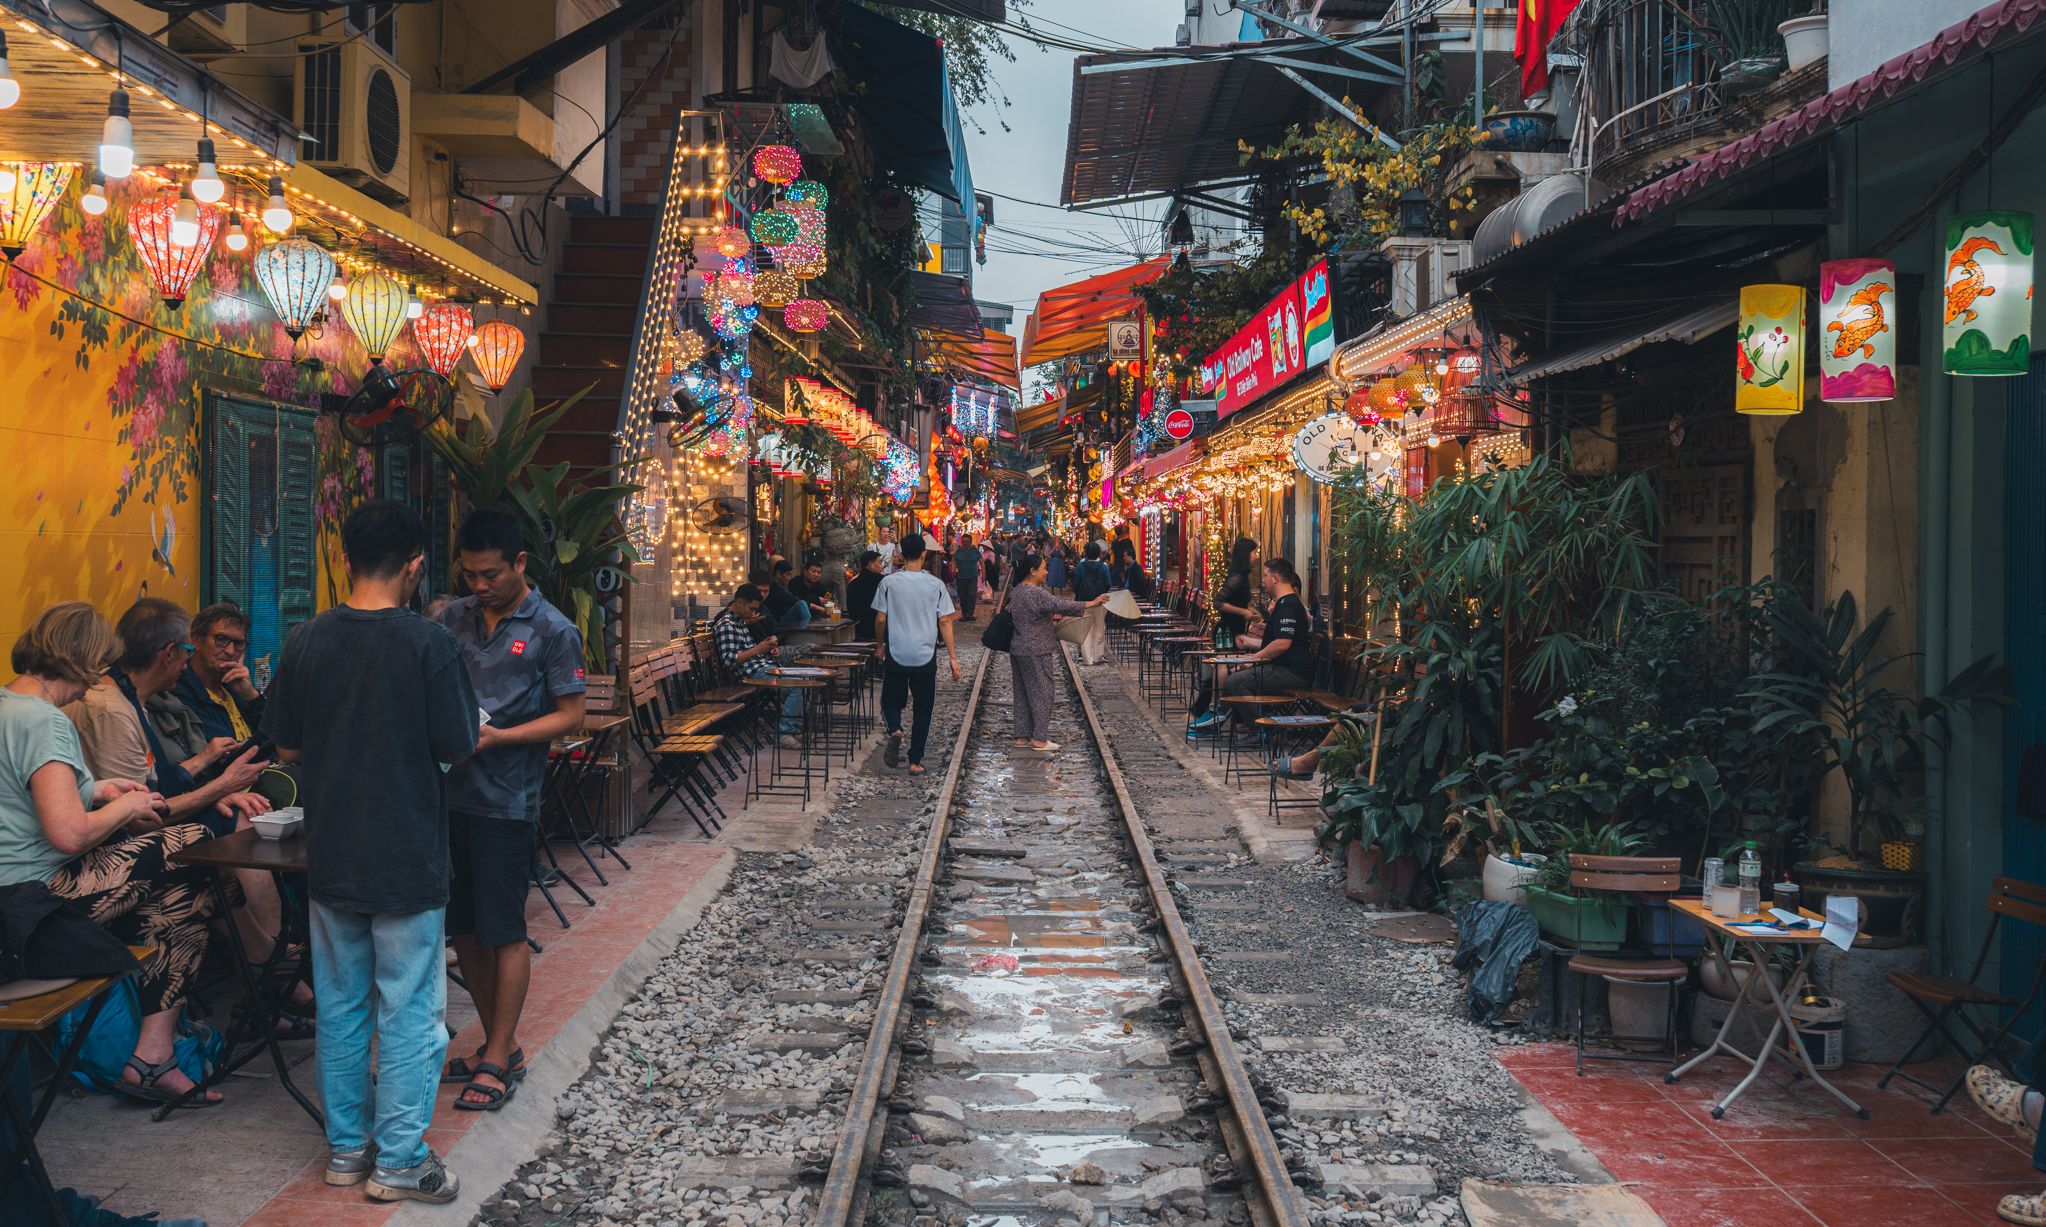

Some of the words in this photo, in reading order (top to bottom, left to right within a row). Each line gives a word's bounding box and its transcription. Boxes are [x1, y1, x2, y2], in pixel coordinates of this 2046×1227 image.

[1227, 354, 1236, 379] Old
[1168, 420, 1190, 429] Coca-Cola
[1303, 424, 1326, 445] OLD
